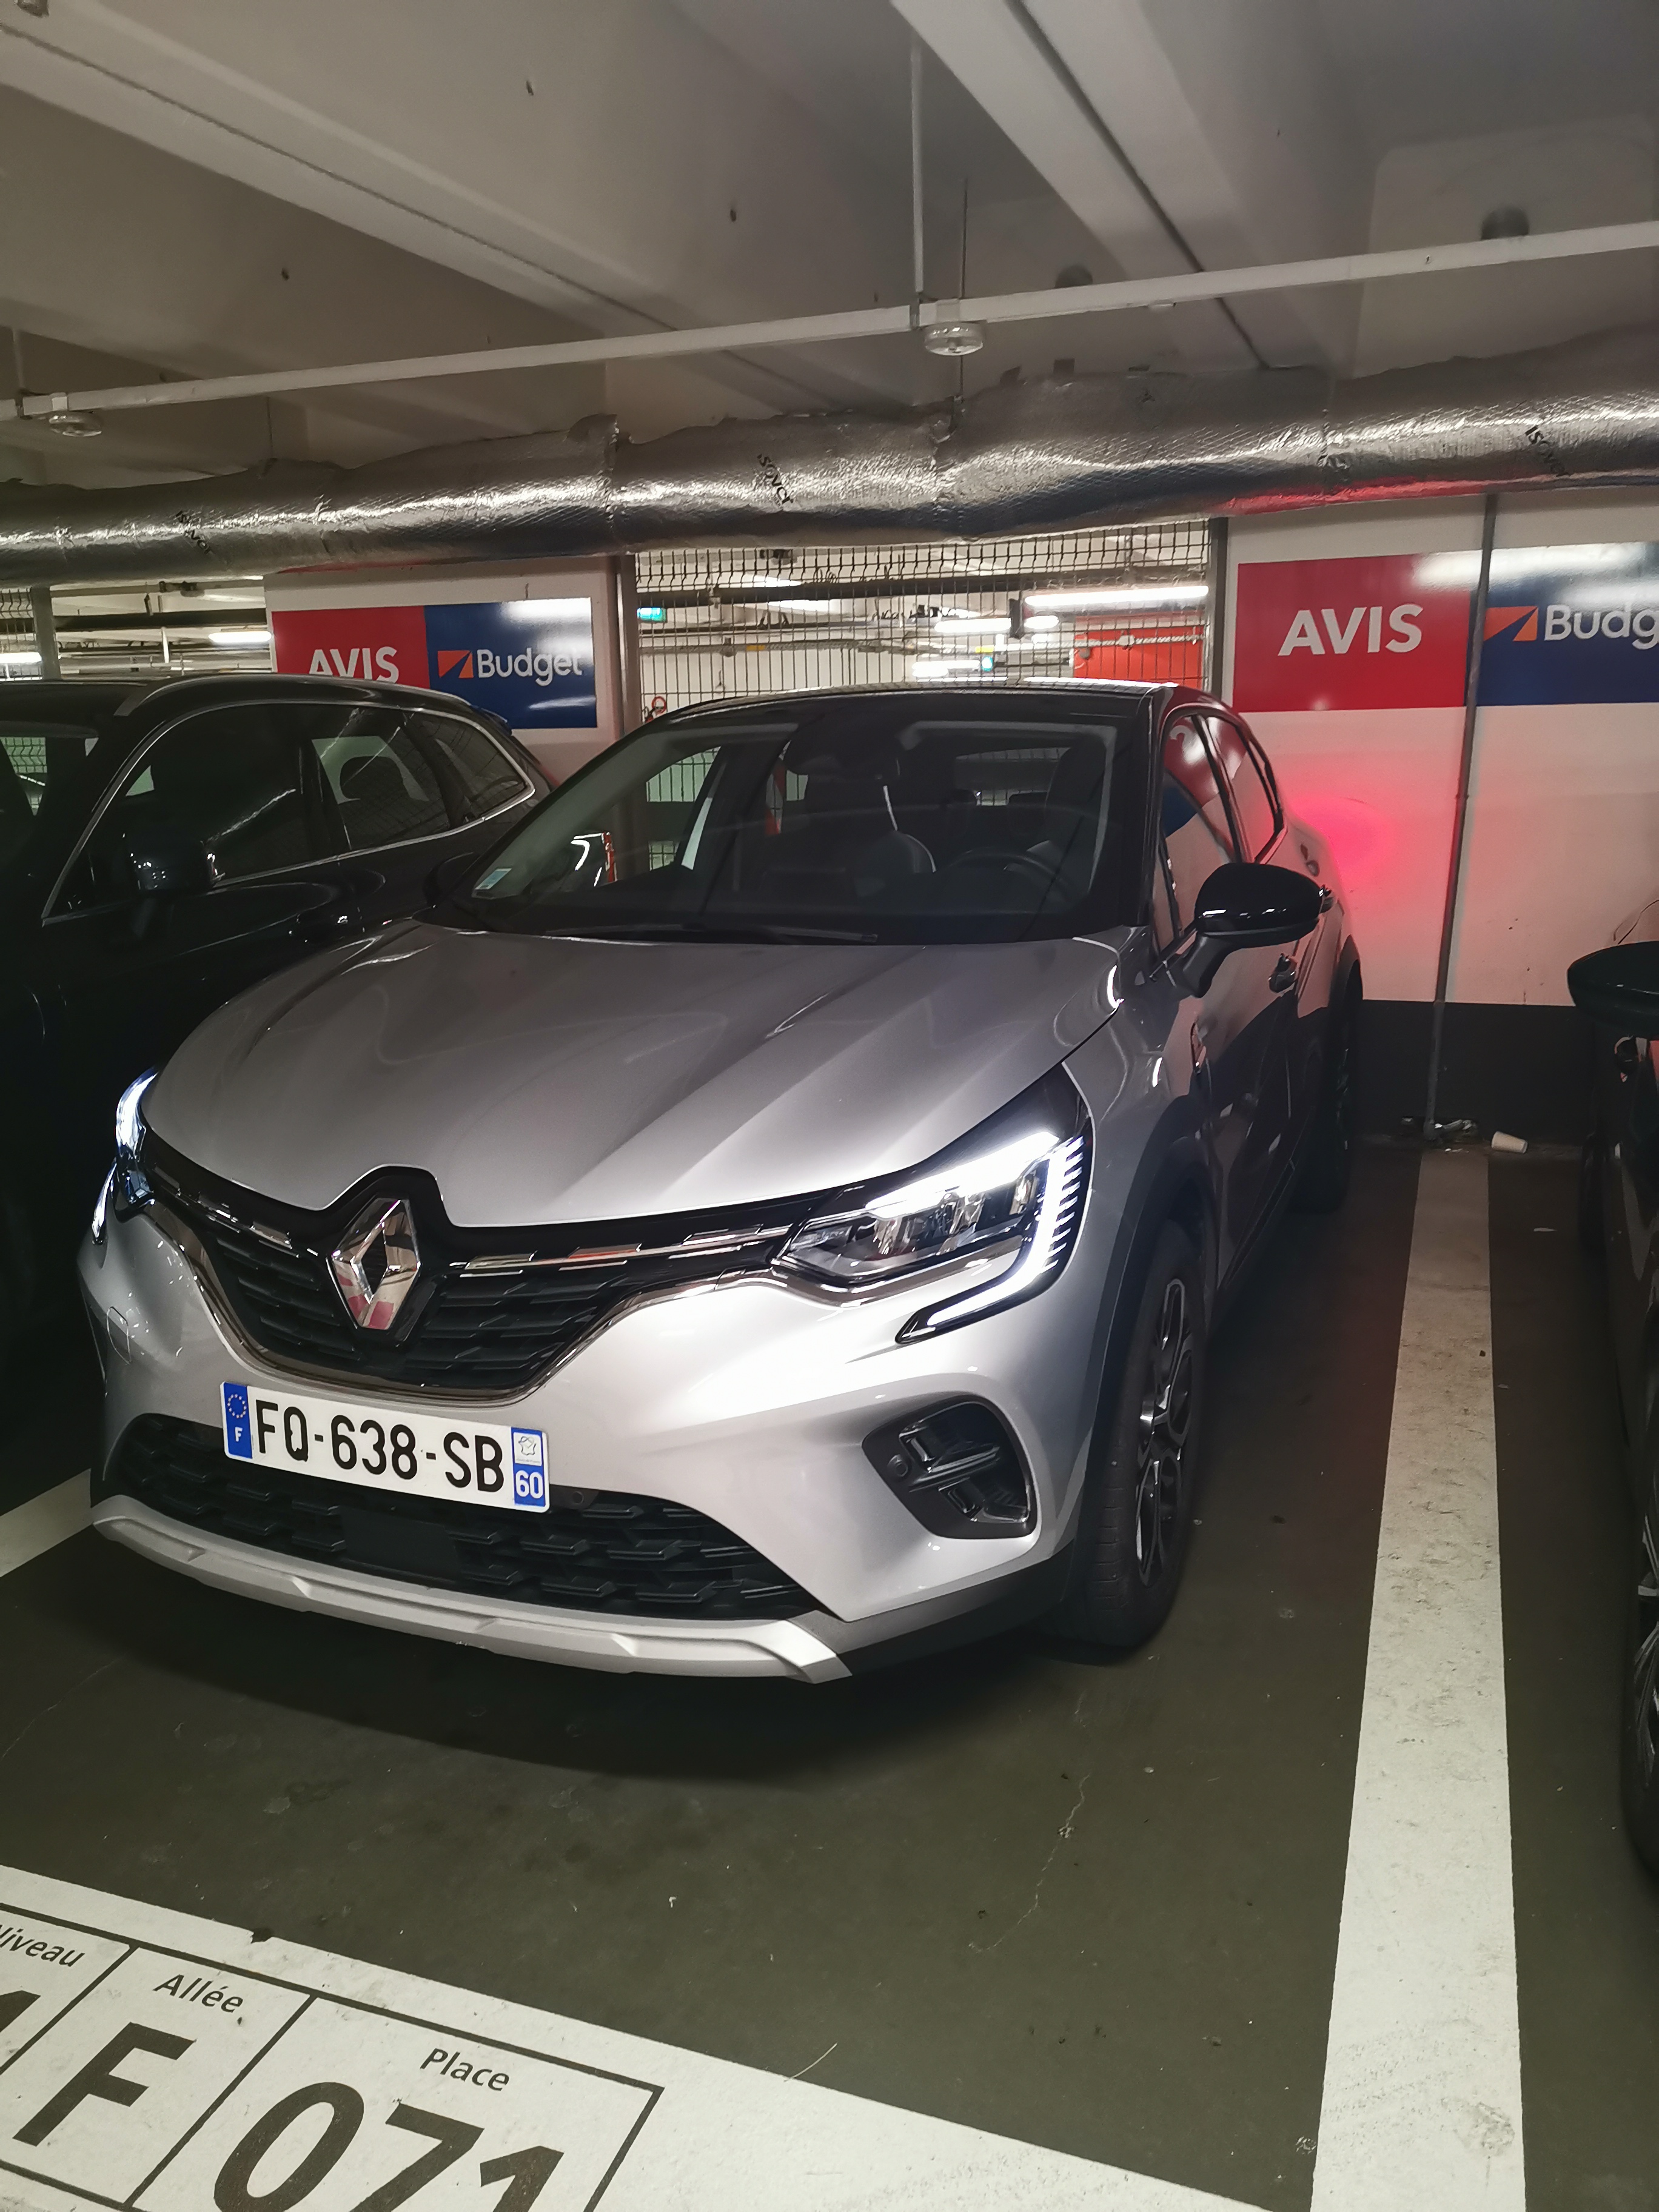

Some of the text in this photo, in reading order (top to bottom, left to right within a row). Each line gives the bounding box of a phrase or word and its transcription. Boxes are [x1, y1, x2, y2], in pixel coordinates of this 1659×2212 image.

[1278, 604, 1424, 657] AVIS
[309, 646, 582, 686] AVIS Budget
[235, 1426, 243, 1442] F
[255, 1399, 504, 1493] FQ-638-SB
[515, 1470, 543, 1499] 60
[153, 1974, 244, 2013] Allée
[12, 2022, 196, 2147] F
[420, 2048, 509, 2091] Place
